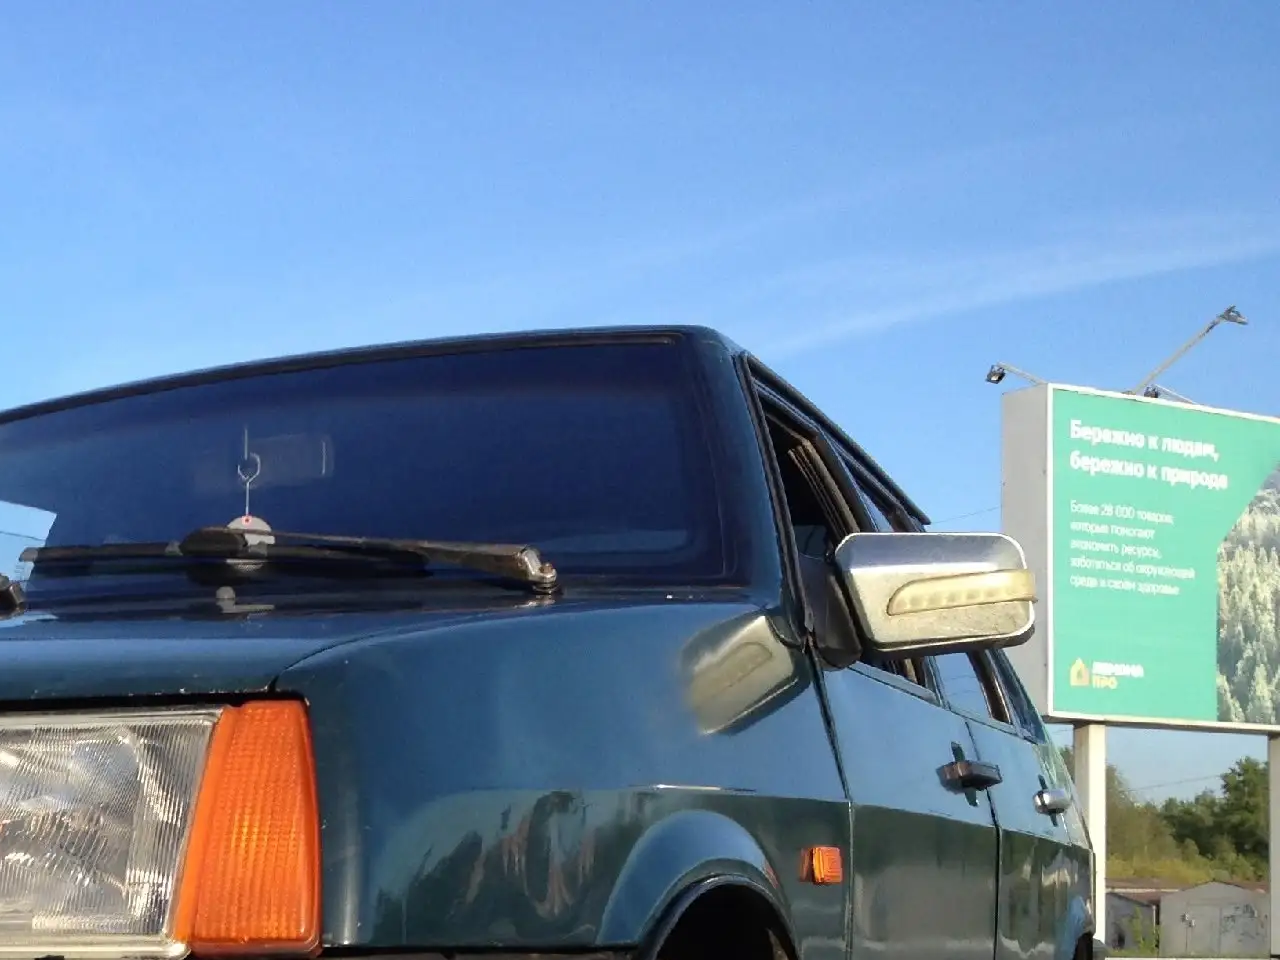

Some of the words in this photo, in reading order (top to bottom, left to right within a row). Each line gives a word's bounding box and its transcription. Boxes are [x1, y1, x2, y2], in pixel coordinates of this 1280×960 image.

[1070, 420, 1145, 448] Бережно
[1148, 435, 1158, 450] к
[1070, 451, 1145, 477] бережно
[1147, 464, 1158, 480] к
[1161, 466, 1228, 491] природе
[1092, 674, 1118, 690] ПРО
